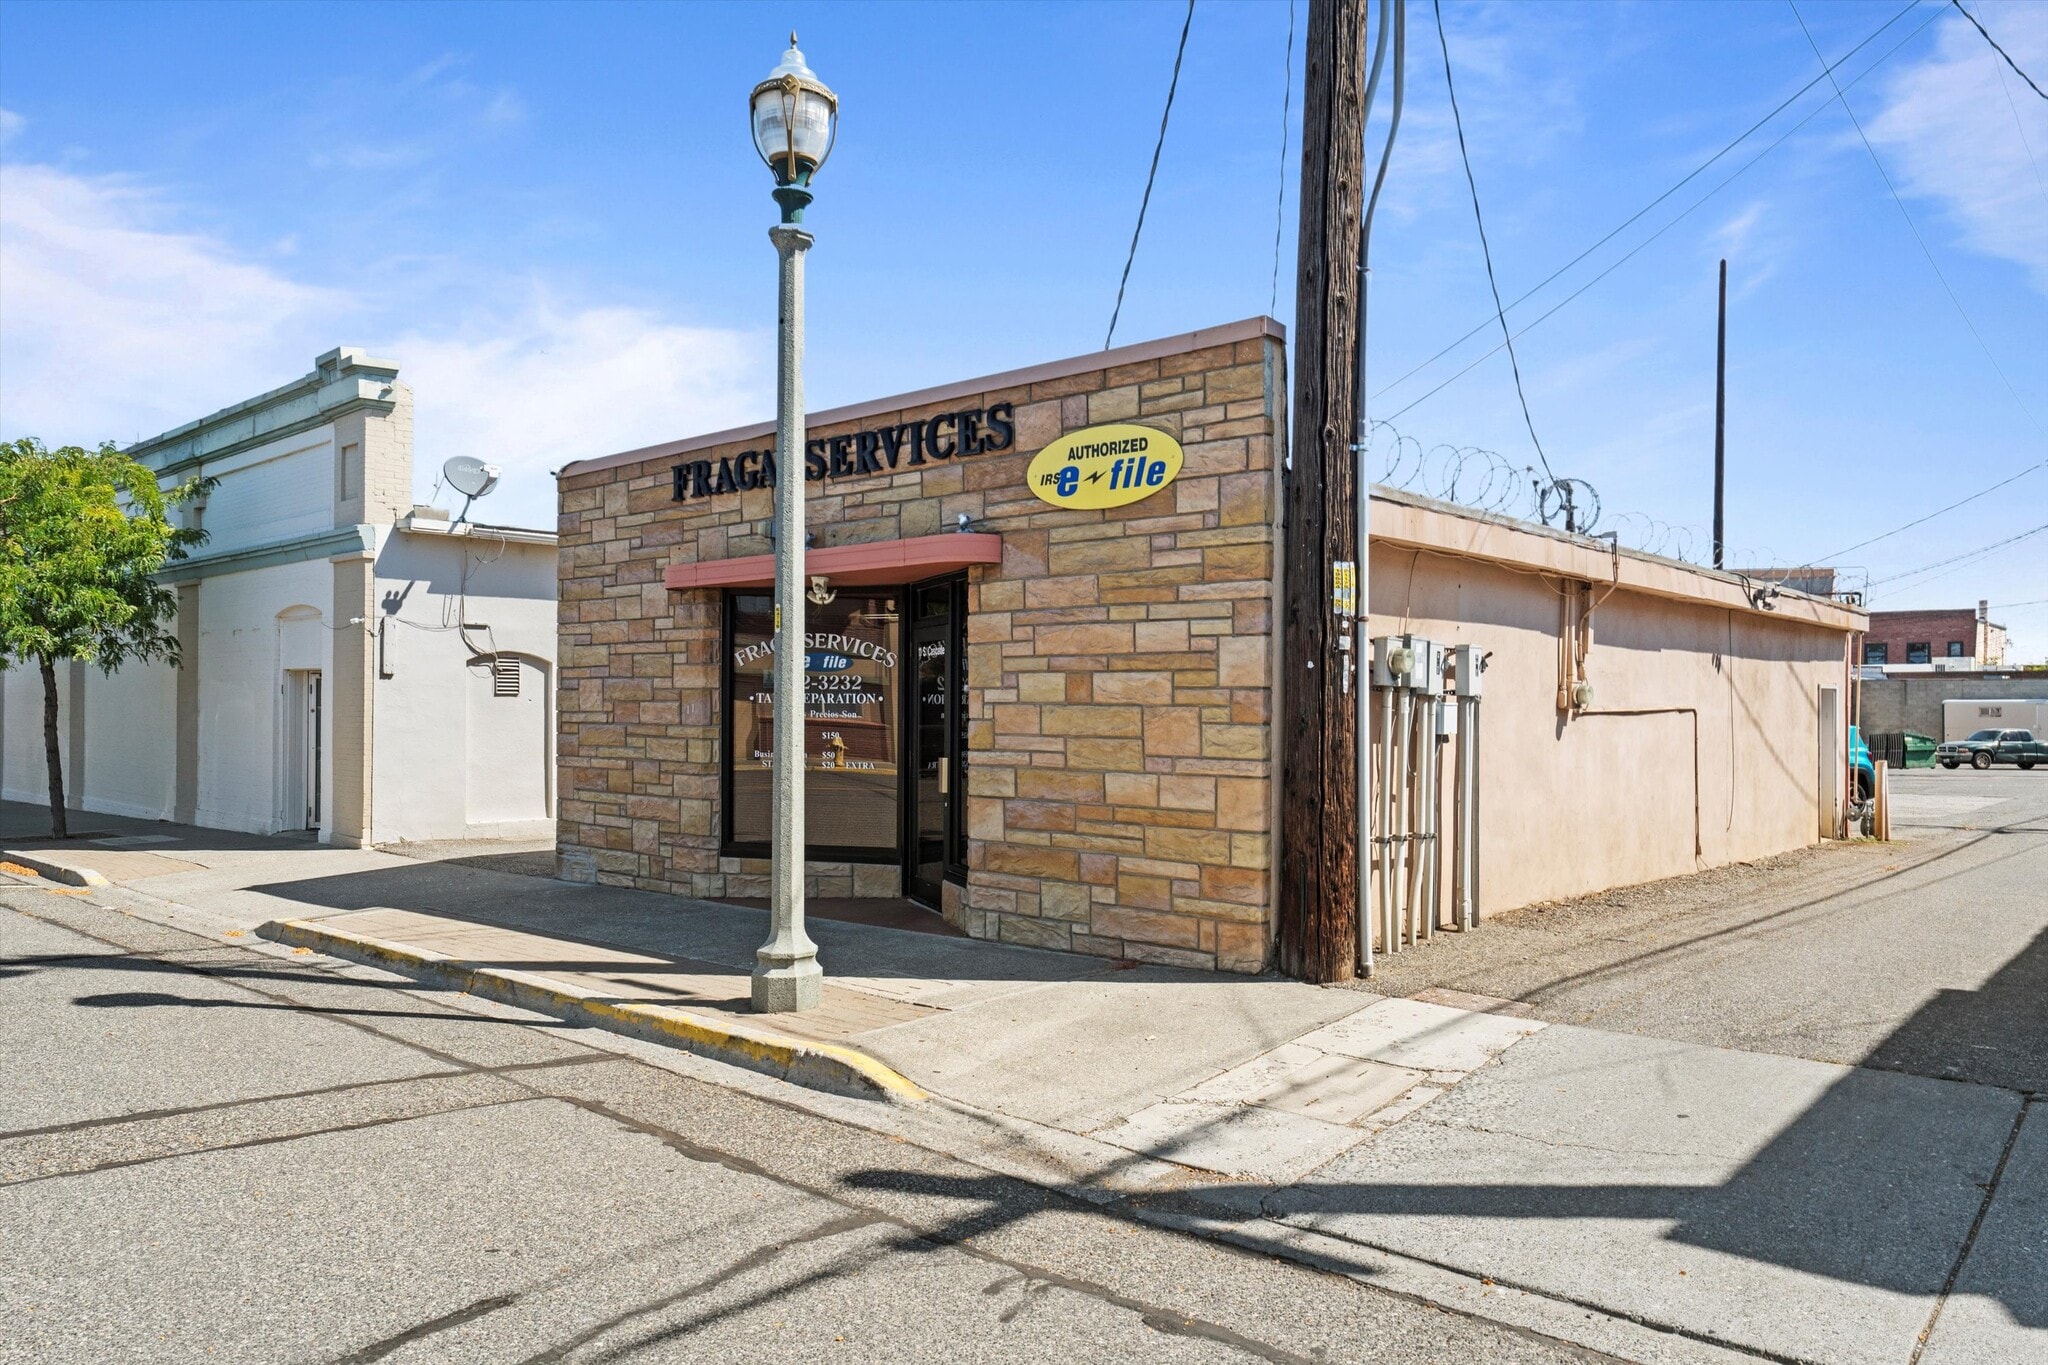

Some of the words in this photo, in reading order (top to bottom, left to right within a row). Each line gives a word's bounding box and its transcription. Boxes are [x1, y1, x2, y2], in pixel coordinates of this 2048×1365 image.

[671, 449, 776, 501] FRAGA
[804, 402, 1014, 482] SERVICES
[1067, 436, 1149, 461] AUTHORIZED
[1040, 472, 1061, 486] IRS
[1056, 465, 1080, 497] e
[1109, 456, 1166, 490] file
[734, 637, 775, 667] FRA
[804, 632, 898, 668] SERVICES
[823, 655, 847, 669] file
[804, 674, 862, 690] 2-3232
[756, 692, 775, 704] TA
[804, 692, 876, 705] EPARATION
[810, 709, 839, 718] Precios
[841, 710, 857, 718] Son
[822, 731, 840, 740] $150
[822, 751, 836, 760] $50
[822, 761, 836, 769] $20
[845, 761, 875, 770] EXTRA
